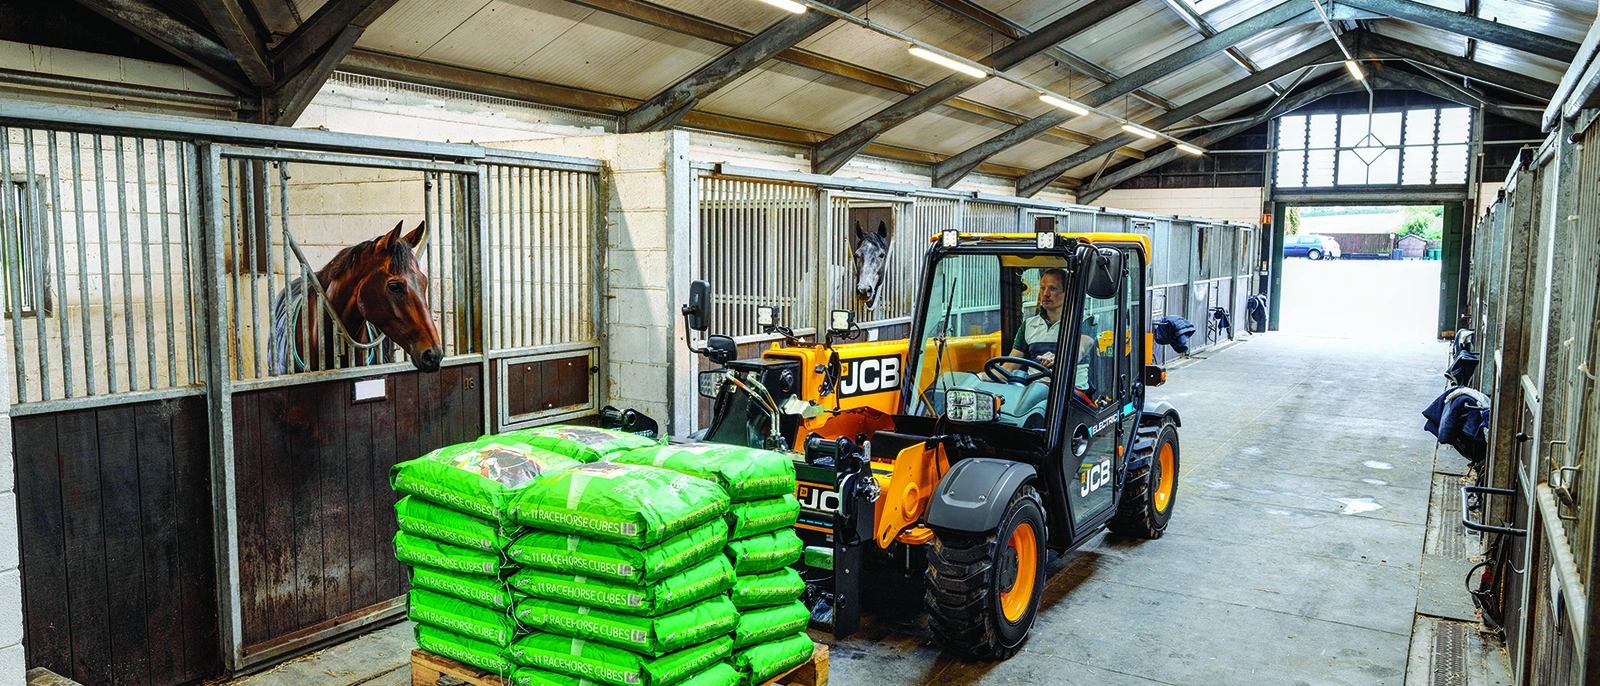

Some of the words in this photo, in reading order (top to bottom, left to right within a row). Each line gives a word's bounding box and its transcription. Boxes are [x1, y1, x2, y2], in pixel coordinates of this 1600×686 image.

[841, 357, 900, 395] JCB
[1092, 413, 1118, 435] ELECTRIC
[1081, 460, 1110, 498] JCB
[411, 482, 419, 491] 11
[420, 484, 465, 505] RACEHORSE
[464, 498, 492, 515] CUBES
[799, 489, 839, 512] JC
[530, 510, 539, 519] 11
[540, 510, 588, 528] RACEHORSE
[590, 520, 619, 534] CUBES
[458, 534, 482, 548] CUBES
[410, 550, 416, 558] 11
[416, 552, 458, 569] RACEHORSE
[459, 560, 482, 571] CUBES
[532, 553, 539, 562] 11
[541, 554, 587, 569] RACEHORSE
[588, 560, 617, 574] CUBES
[423, 576, 430, 585] 11
[430, 578, 470, 595] RACEHORSE
[471, 588, 494, 601] CUBES
[537, 582, 545, 592] 11
[546, 583, 596, 600] RACEHORSE
[597, 592, 627, 605] CUBES
[424, 611, 430, 619] 11
[430, 612, 473, 632] RACEHORSE
[474, 626, 498, 640] CUBES
[542, 614, 548, 623] 11
[550, 614, 599, 631] RACEHORSE
[599, 624, 630, 640] CUBES
[439, 644, 481, 666] RACEHORSE
[534, 654, 542, 662] 11
[543, 655, 592, 674] RACEHORSE
[594, 666, 623, 682] CUBES
